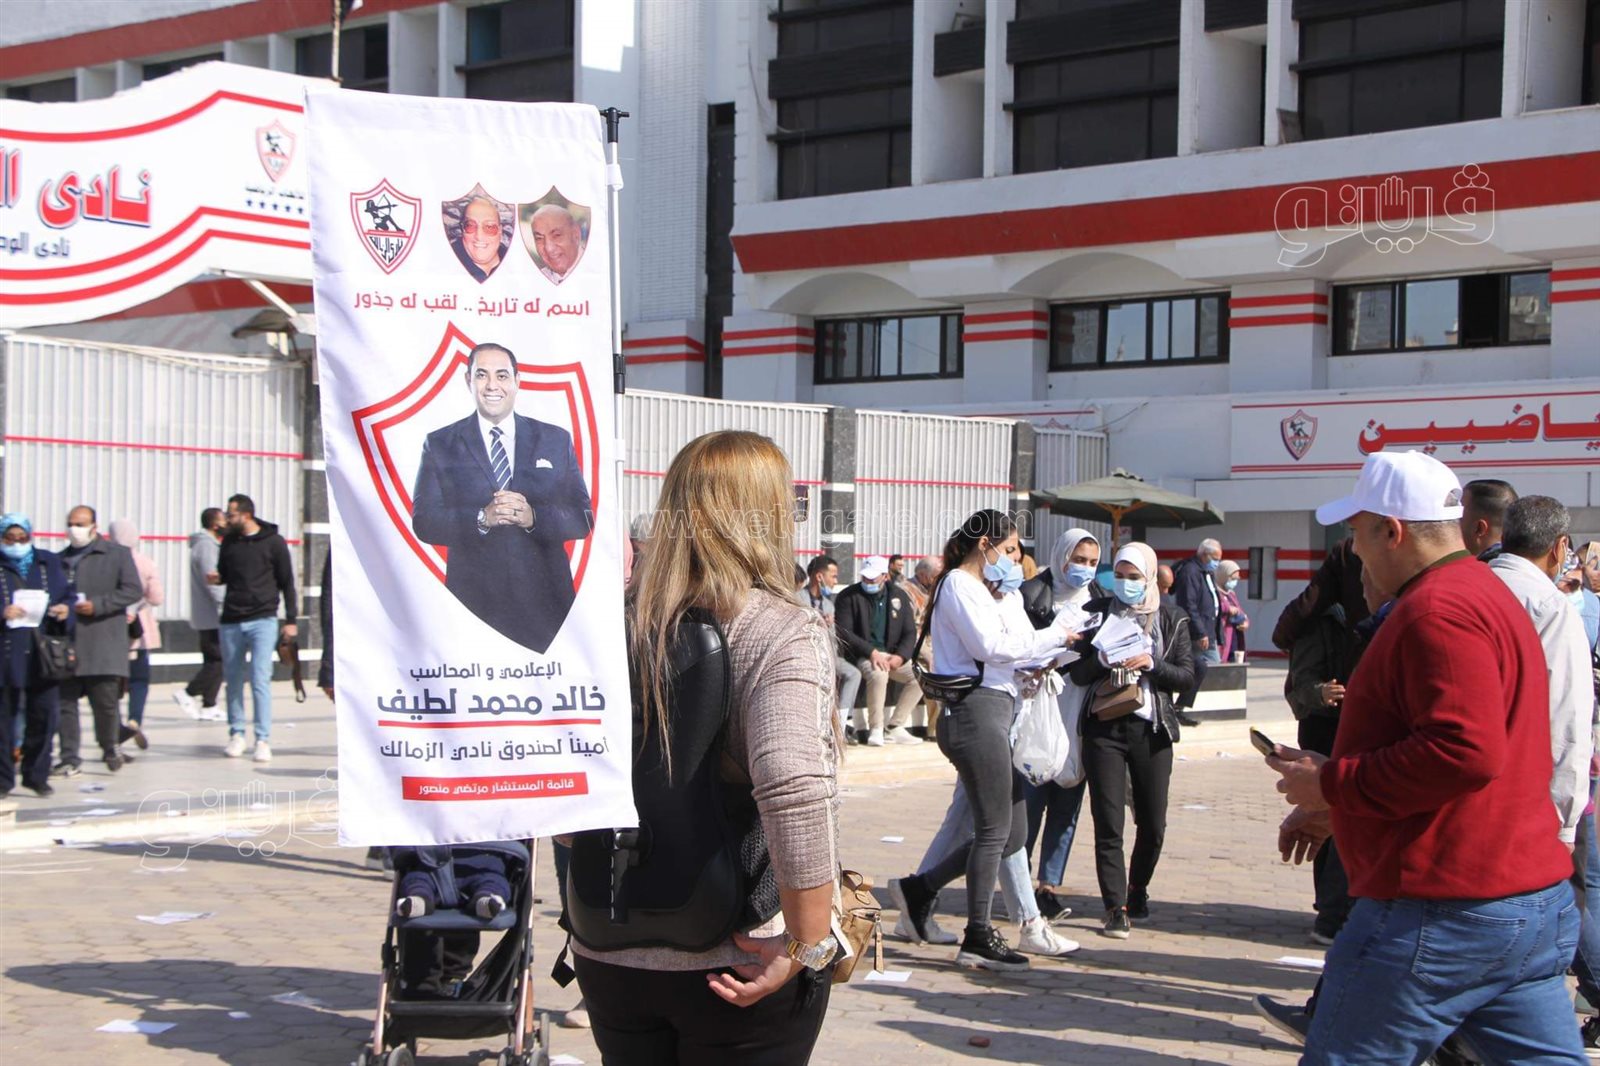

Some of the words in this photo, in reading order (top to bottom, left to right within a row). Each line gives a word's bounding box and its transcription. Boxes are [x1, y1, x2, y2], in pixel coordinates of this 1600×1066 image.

[354, 291, 394, 310] جذور
[400, 293, 417, 308] له
[423, 294, 457, 312] لقب
[477, 296, 519, 317] تاريخ
[523, 298, 540, 313] له
[546, 300, 590, 317] اسم
[410, 663, 481, 682] المحاسب
[486, 667, 494, 680] و
[499, 662, 562, 680] الإعلامي
[377, 687, 457, 721] لطيف
[468, 694, 543, 715] محمد
[552, 685, 606, 711] خالد
[380, 740, 444, 762] الزمالك
[450, 741, 491, 761] نادي
[498, 739, 562, 761] لصندوق
[418, 784, 450, 795] منصور
[491, 780, 544, 794] المستشار
[546, 778, 575, 790] قائمة
